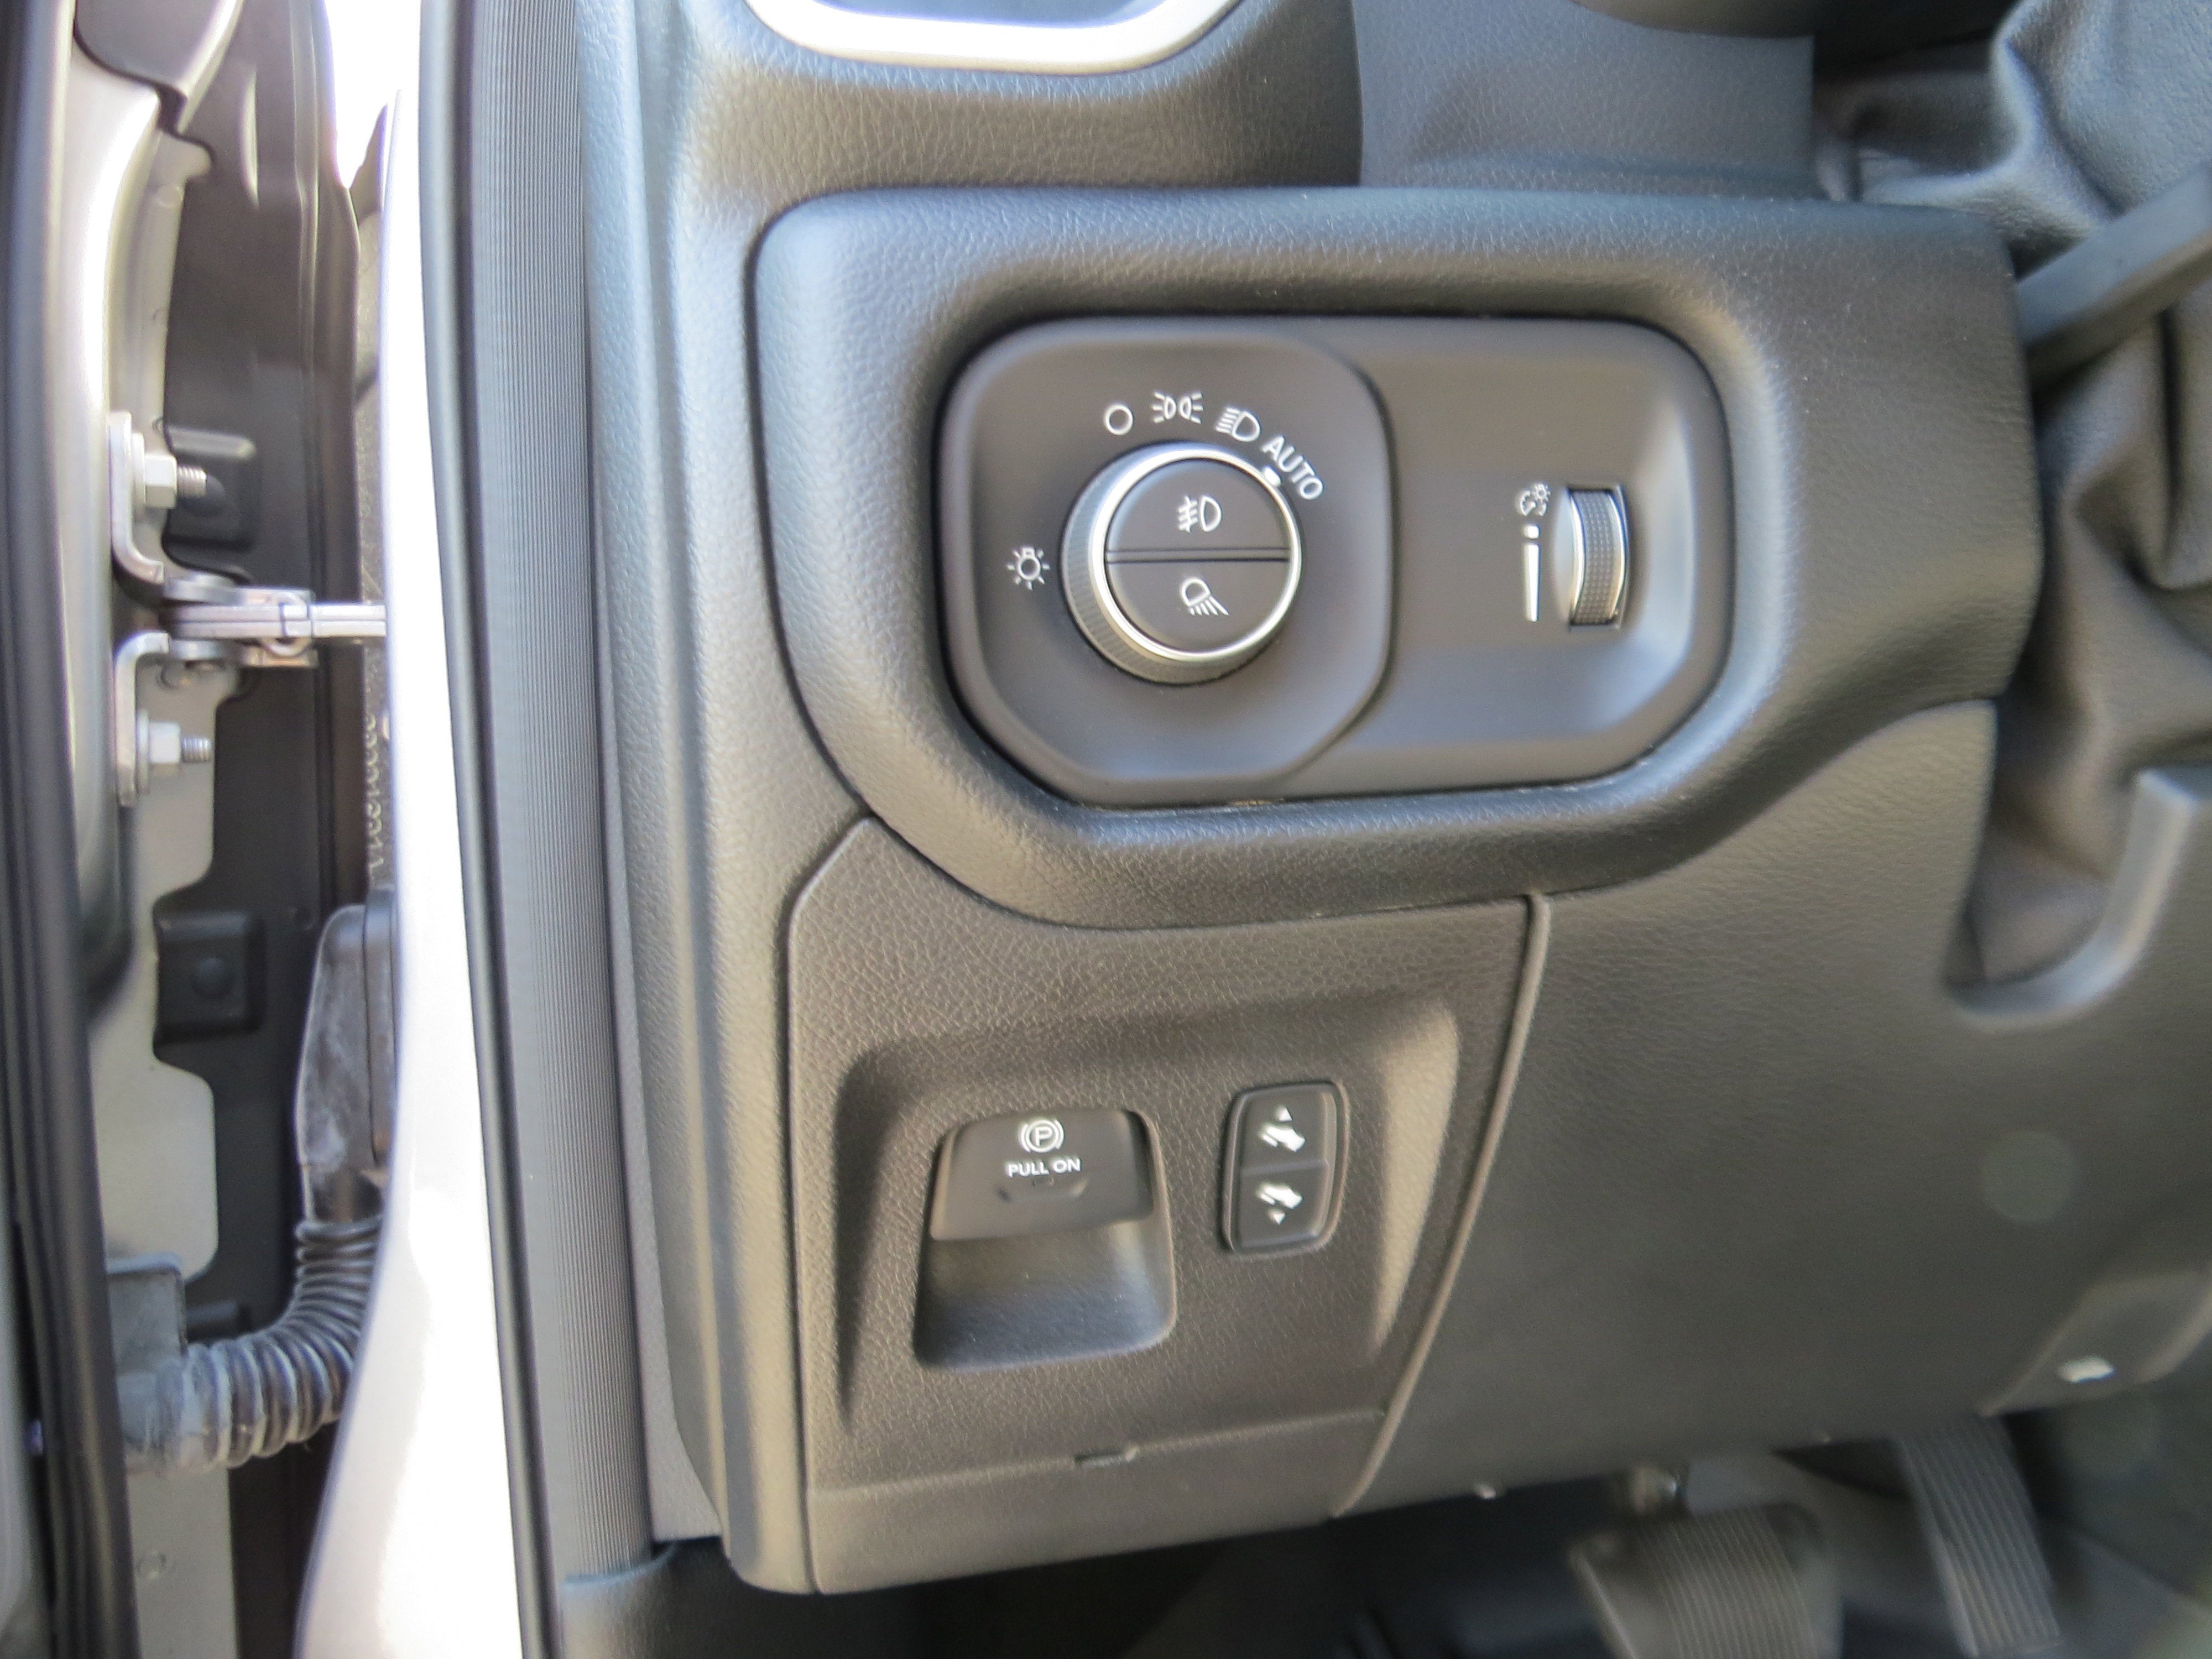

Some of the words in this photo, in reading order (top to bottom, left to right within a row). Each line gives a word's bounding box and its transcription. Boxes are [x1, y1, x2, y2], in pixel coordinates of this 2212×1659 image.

[1261, 436, 1323, 499] AUTO
[1035, 1126, 1053, 1147] P
[1006, 1161, 1050, 1178] PULL
[1052, 1158, 1081, 1174] ON
